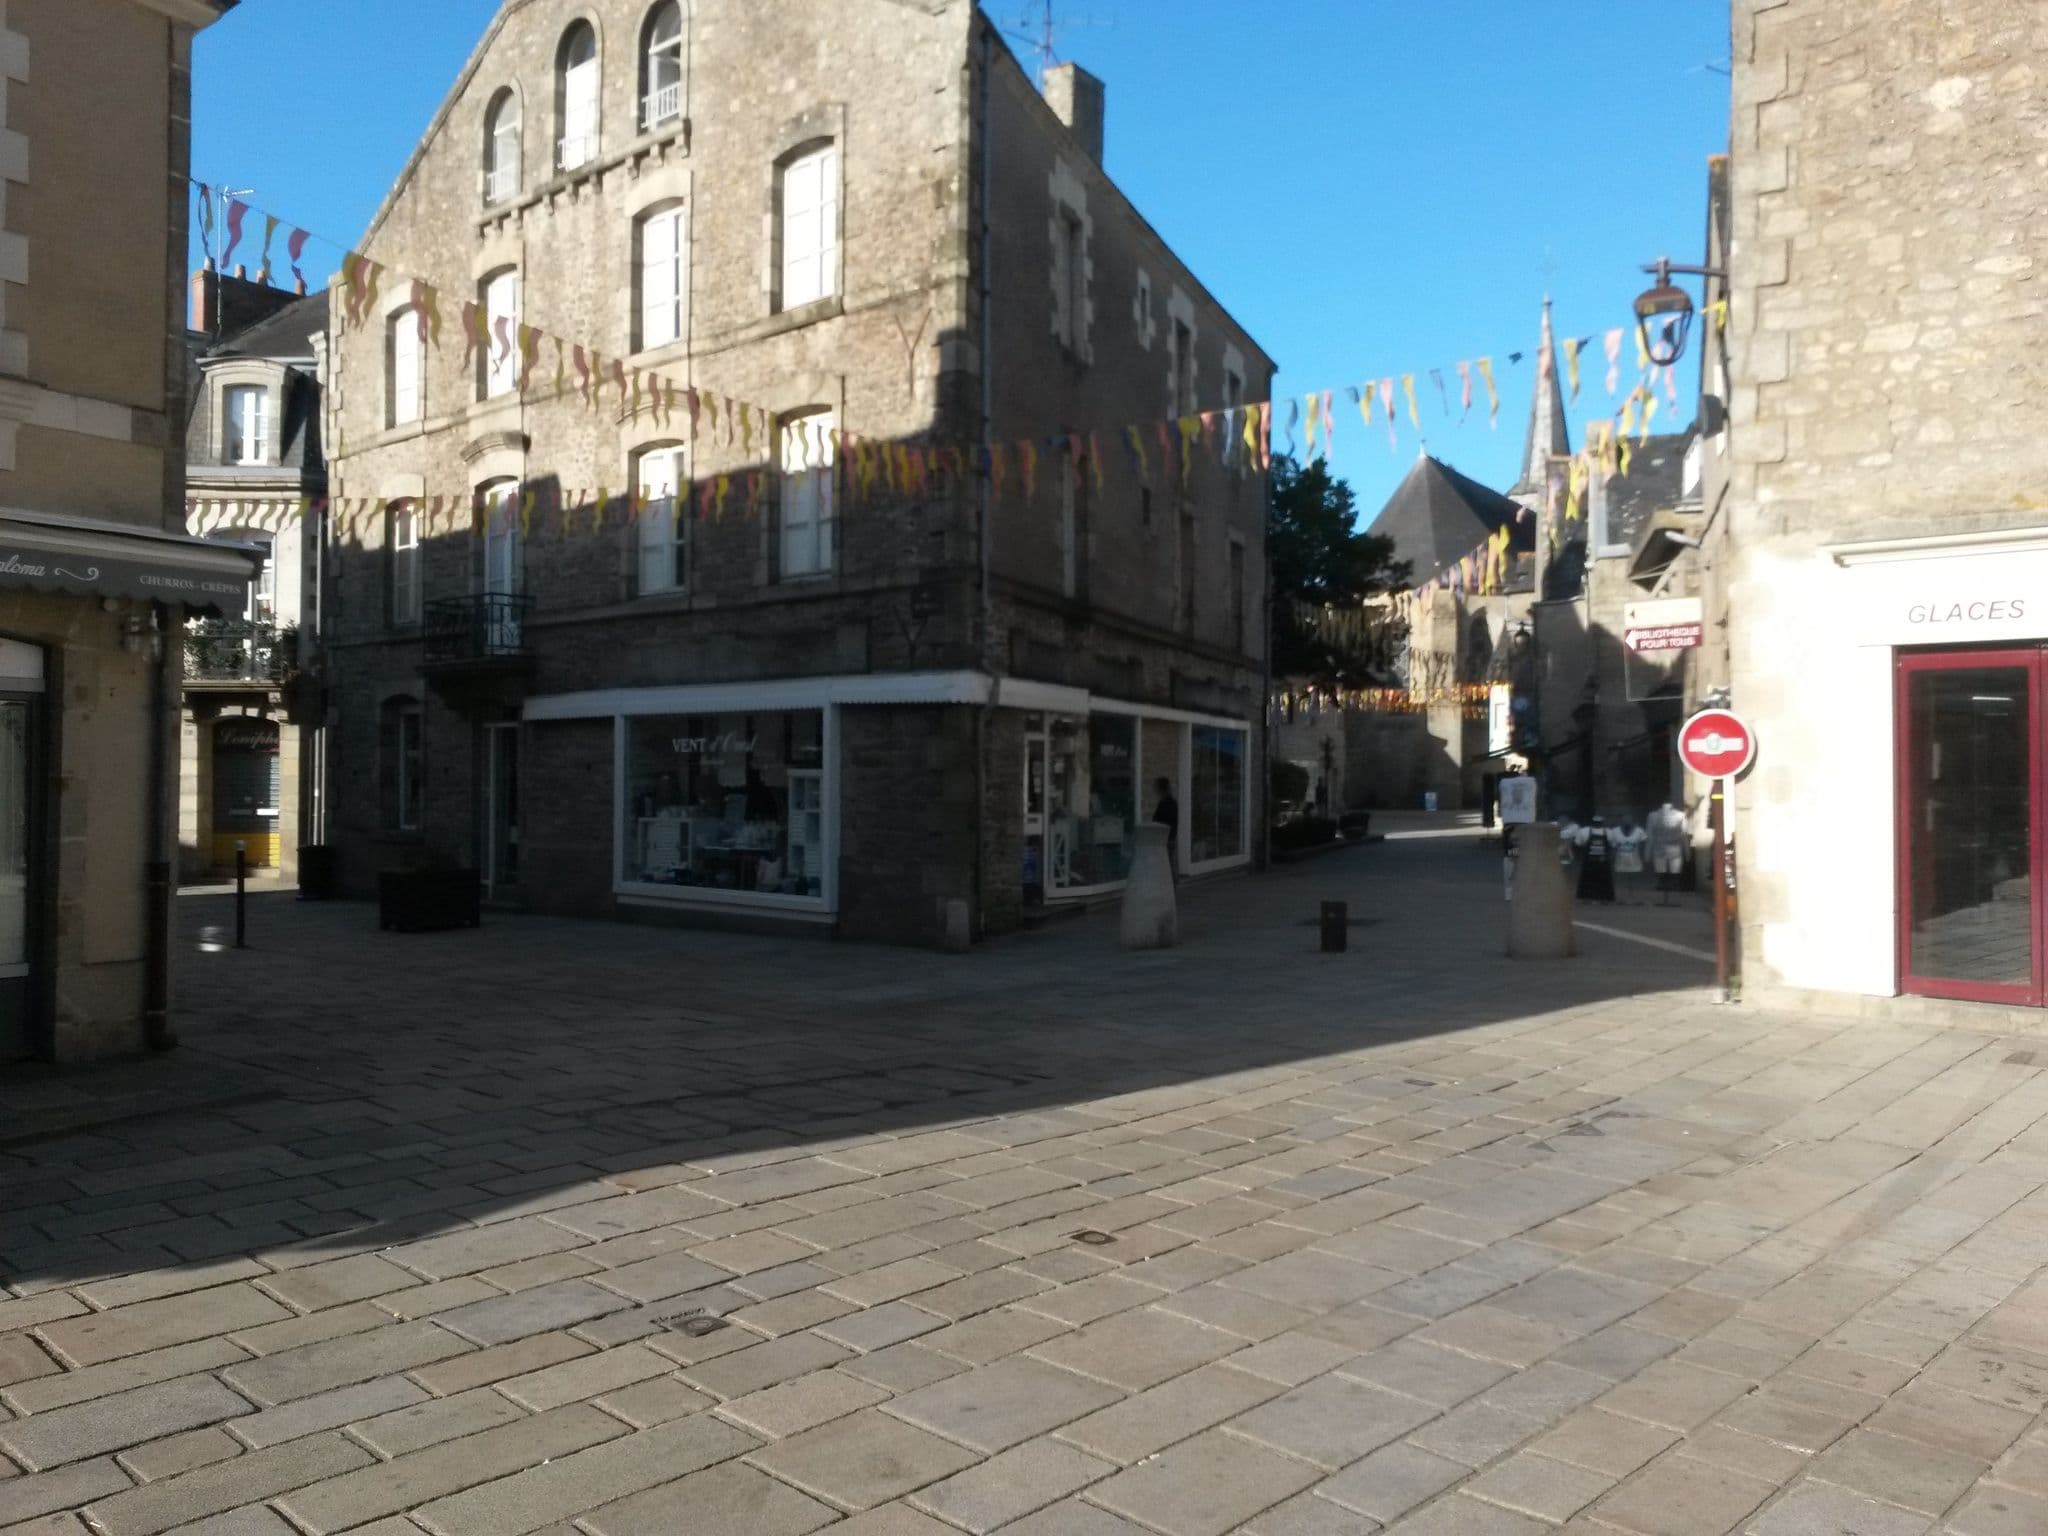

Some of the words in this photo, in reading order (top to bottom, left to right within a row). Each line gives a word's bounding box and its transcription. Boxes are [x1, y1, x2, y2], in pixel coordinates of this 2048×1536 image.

[139, 575, 193, 589] CHURROS
[1908, 599, 2025, 623] GLACES
[1640, 638, 1666, 649] POUR
[1669, 637, 1696, 647] TOUS
[672, 738, 706, 752] VENT
